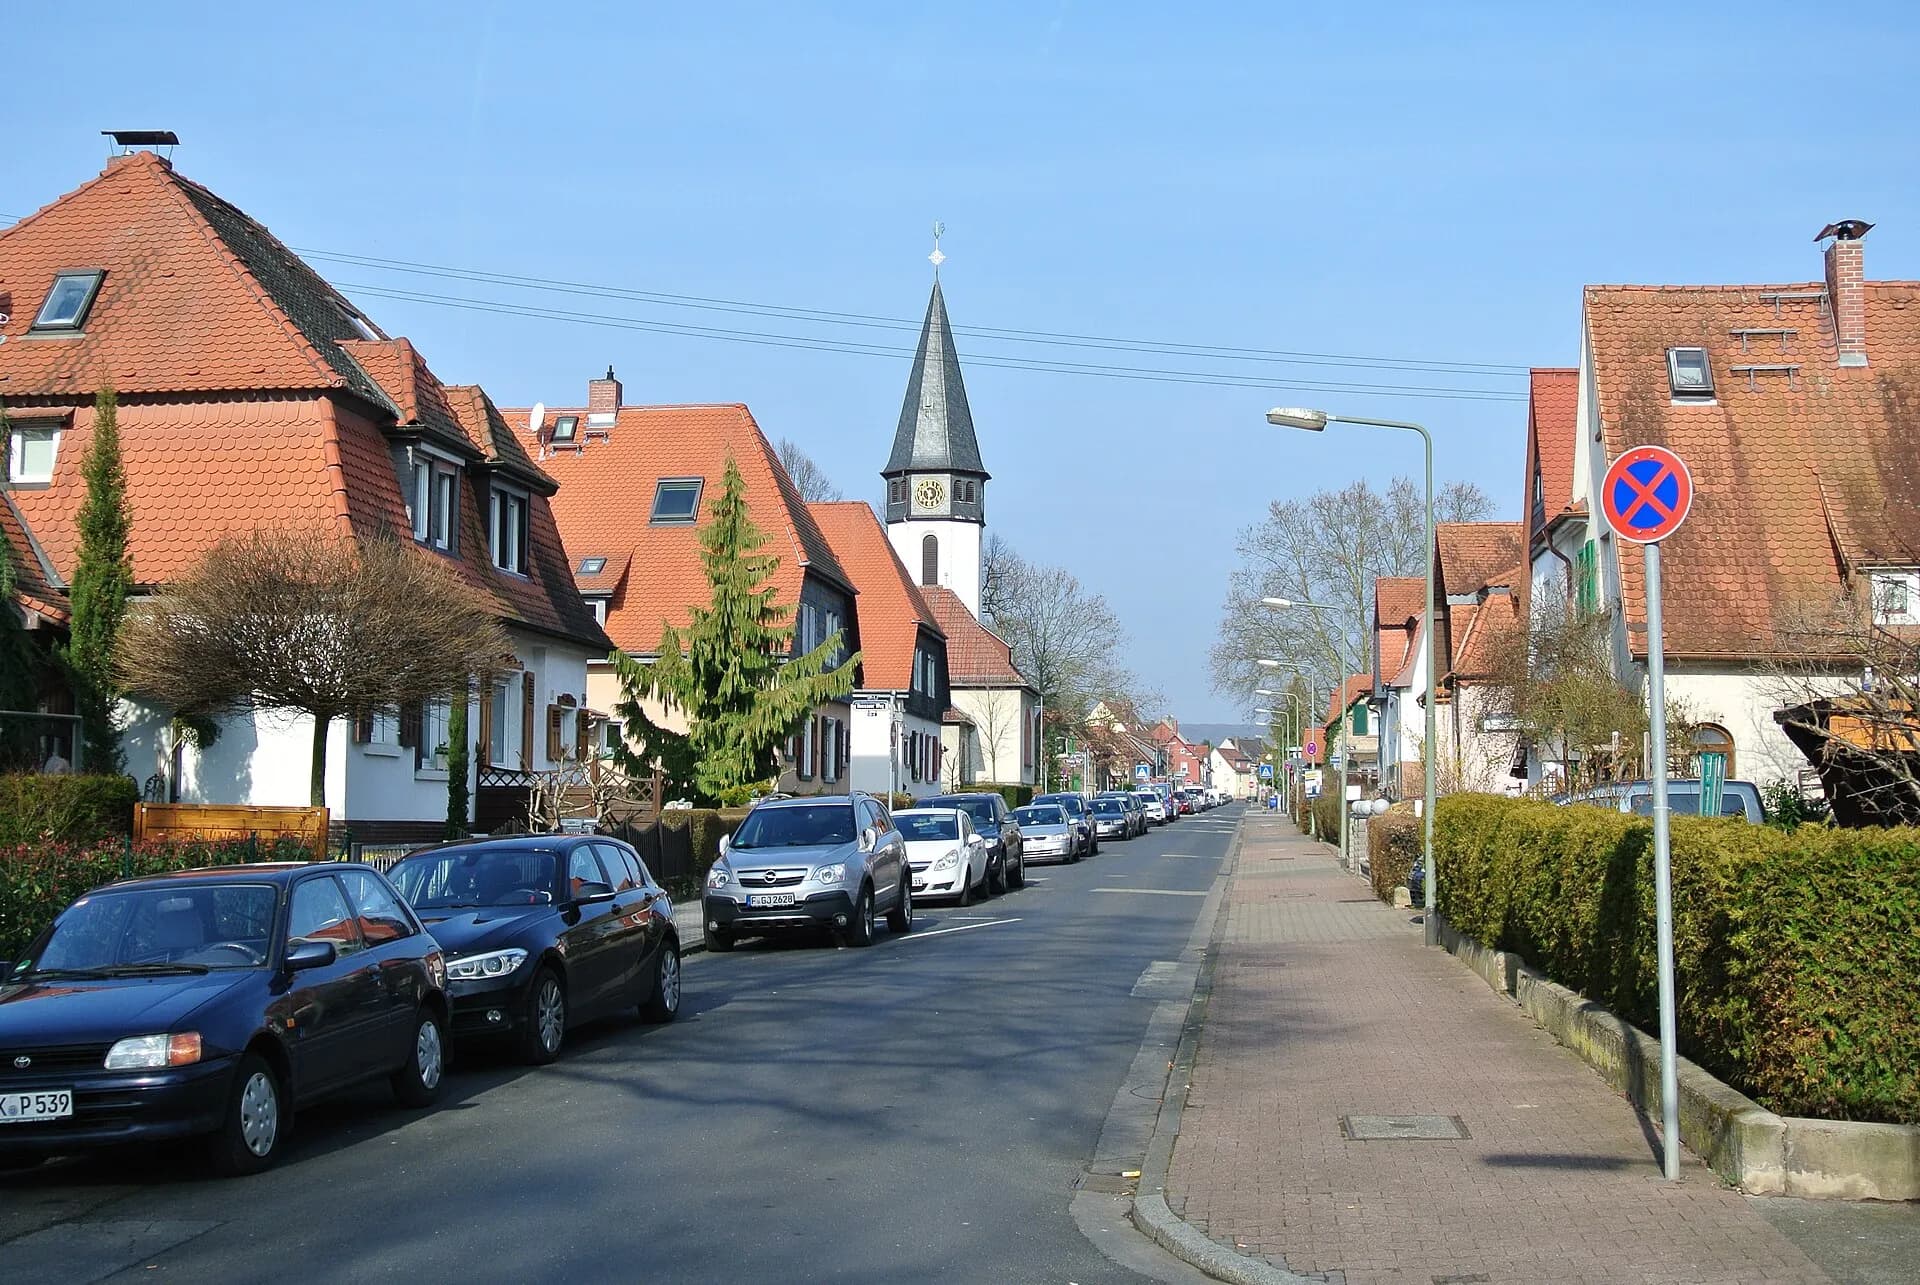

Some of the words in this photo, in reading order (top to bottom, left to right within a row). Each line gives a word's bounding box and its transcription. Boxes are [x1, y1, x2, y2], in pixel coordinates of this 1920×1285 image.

[751, 896, 756, 904] F
[773, 895, 792, 903] 2628
[20, 1096, 31, 1115] P
[35, 1094, 69, 1113] 539
